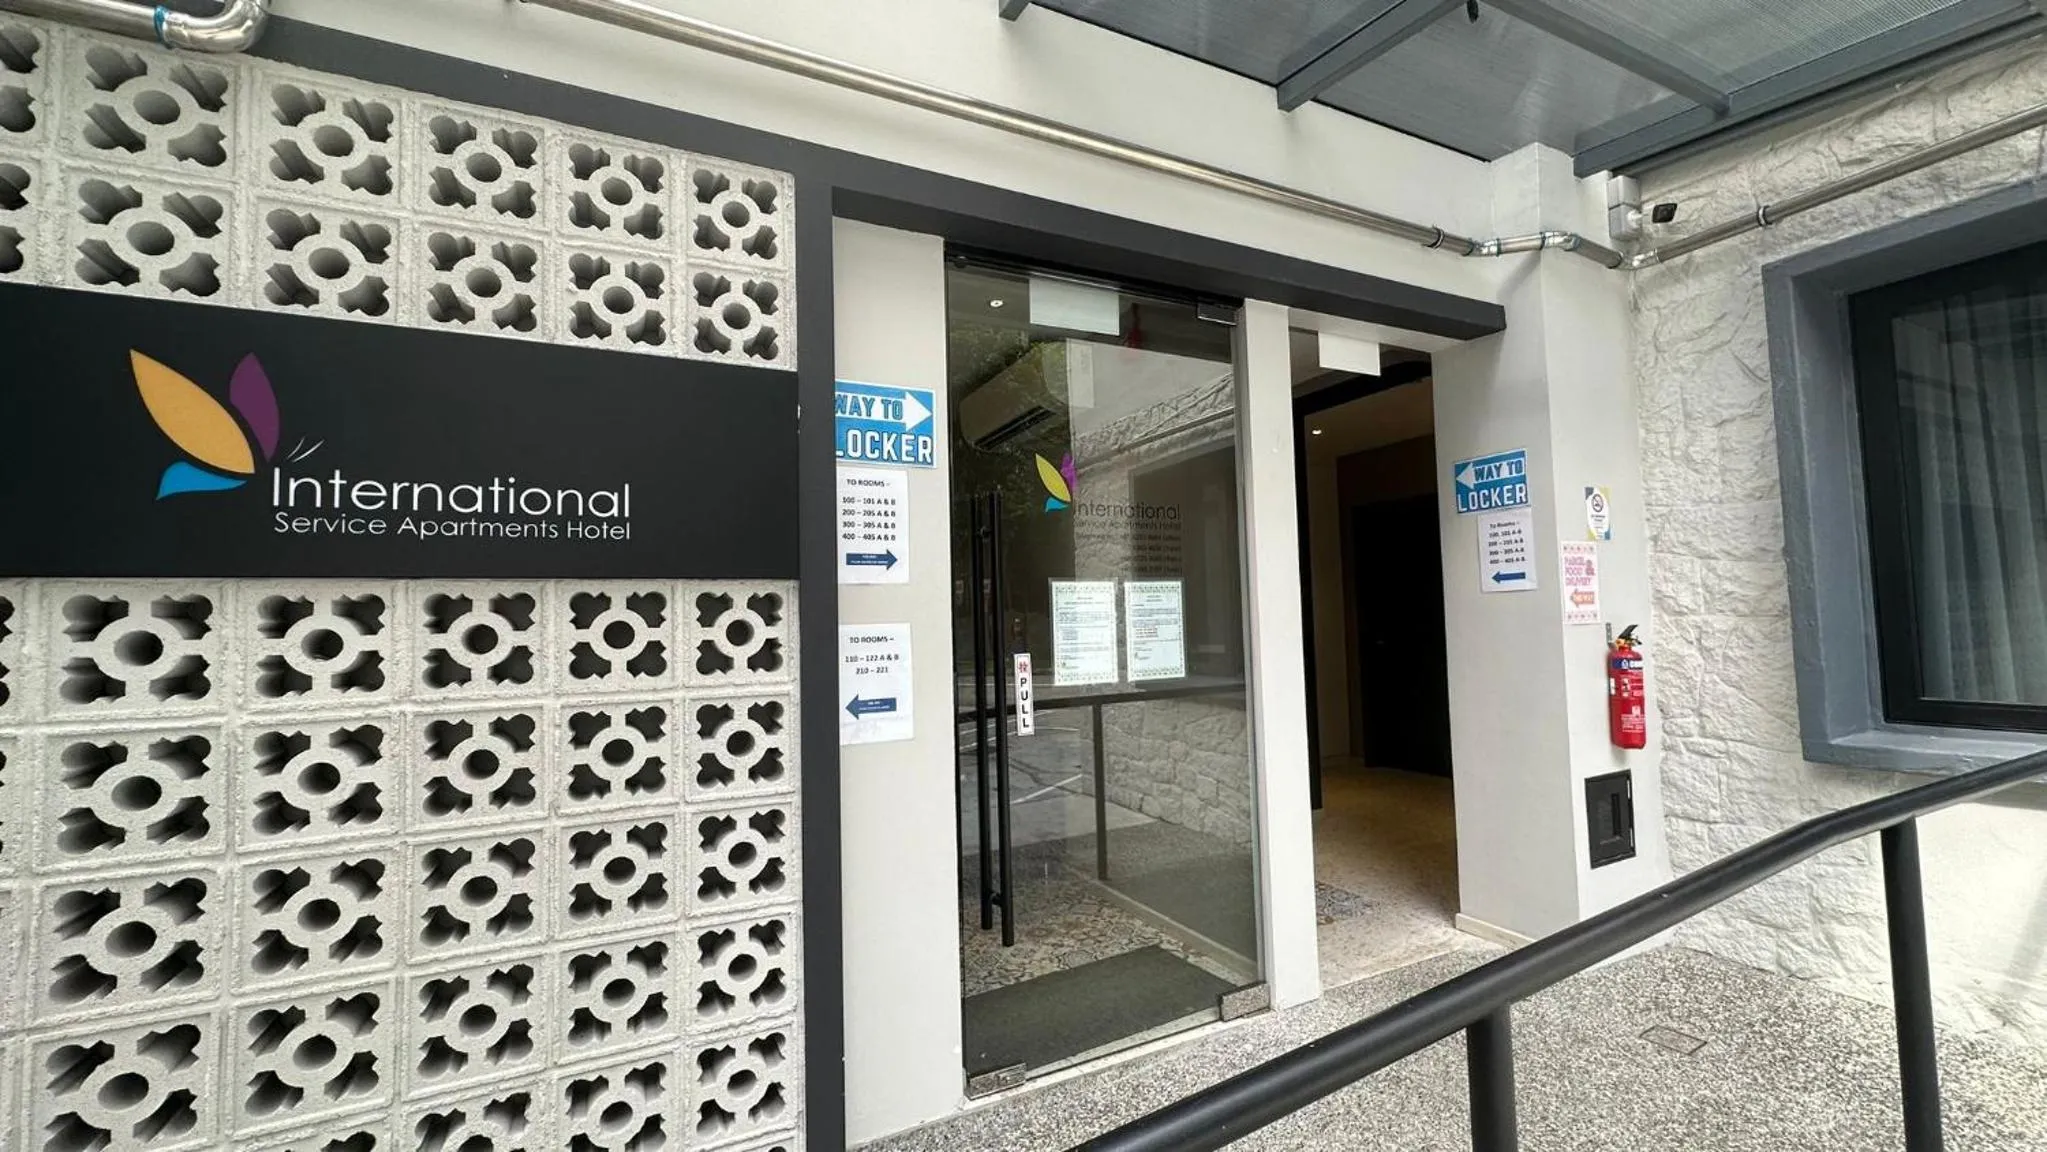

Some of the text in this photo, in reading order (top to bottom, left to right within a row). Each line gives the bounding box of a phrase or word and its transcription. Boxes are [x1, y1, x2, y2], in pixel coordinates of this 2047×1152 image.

[881, 399, 904, 421] TO
[858, 480, 885, 488] ROOMS
[1474, 459, 1524, 481] WAY TO
[272, 466, 631, 518] International
[1457, 483, 1528, 513] LOCKER
[274, 511, 631, 541] Service Apartments Hotel
[1020, 677, 1030, 728] PULL
